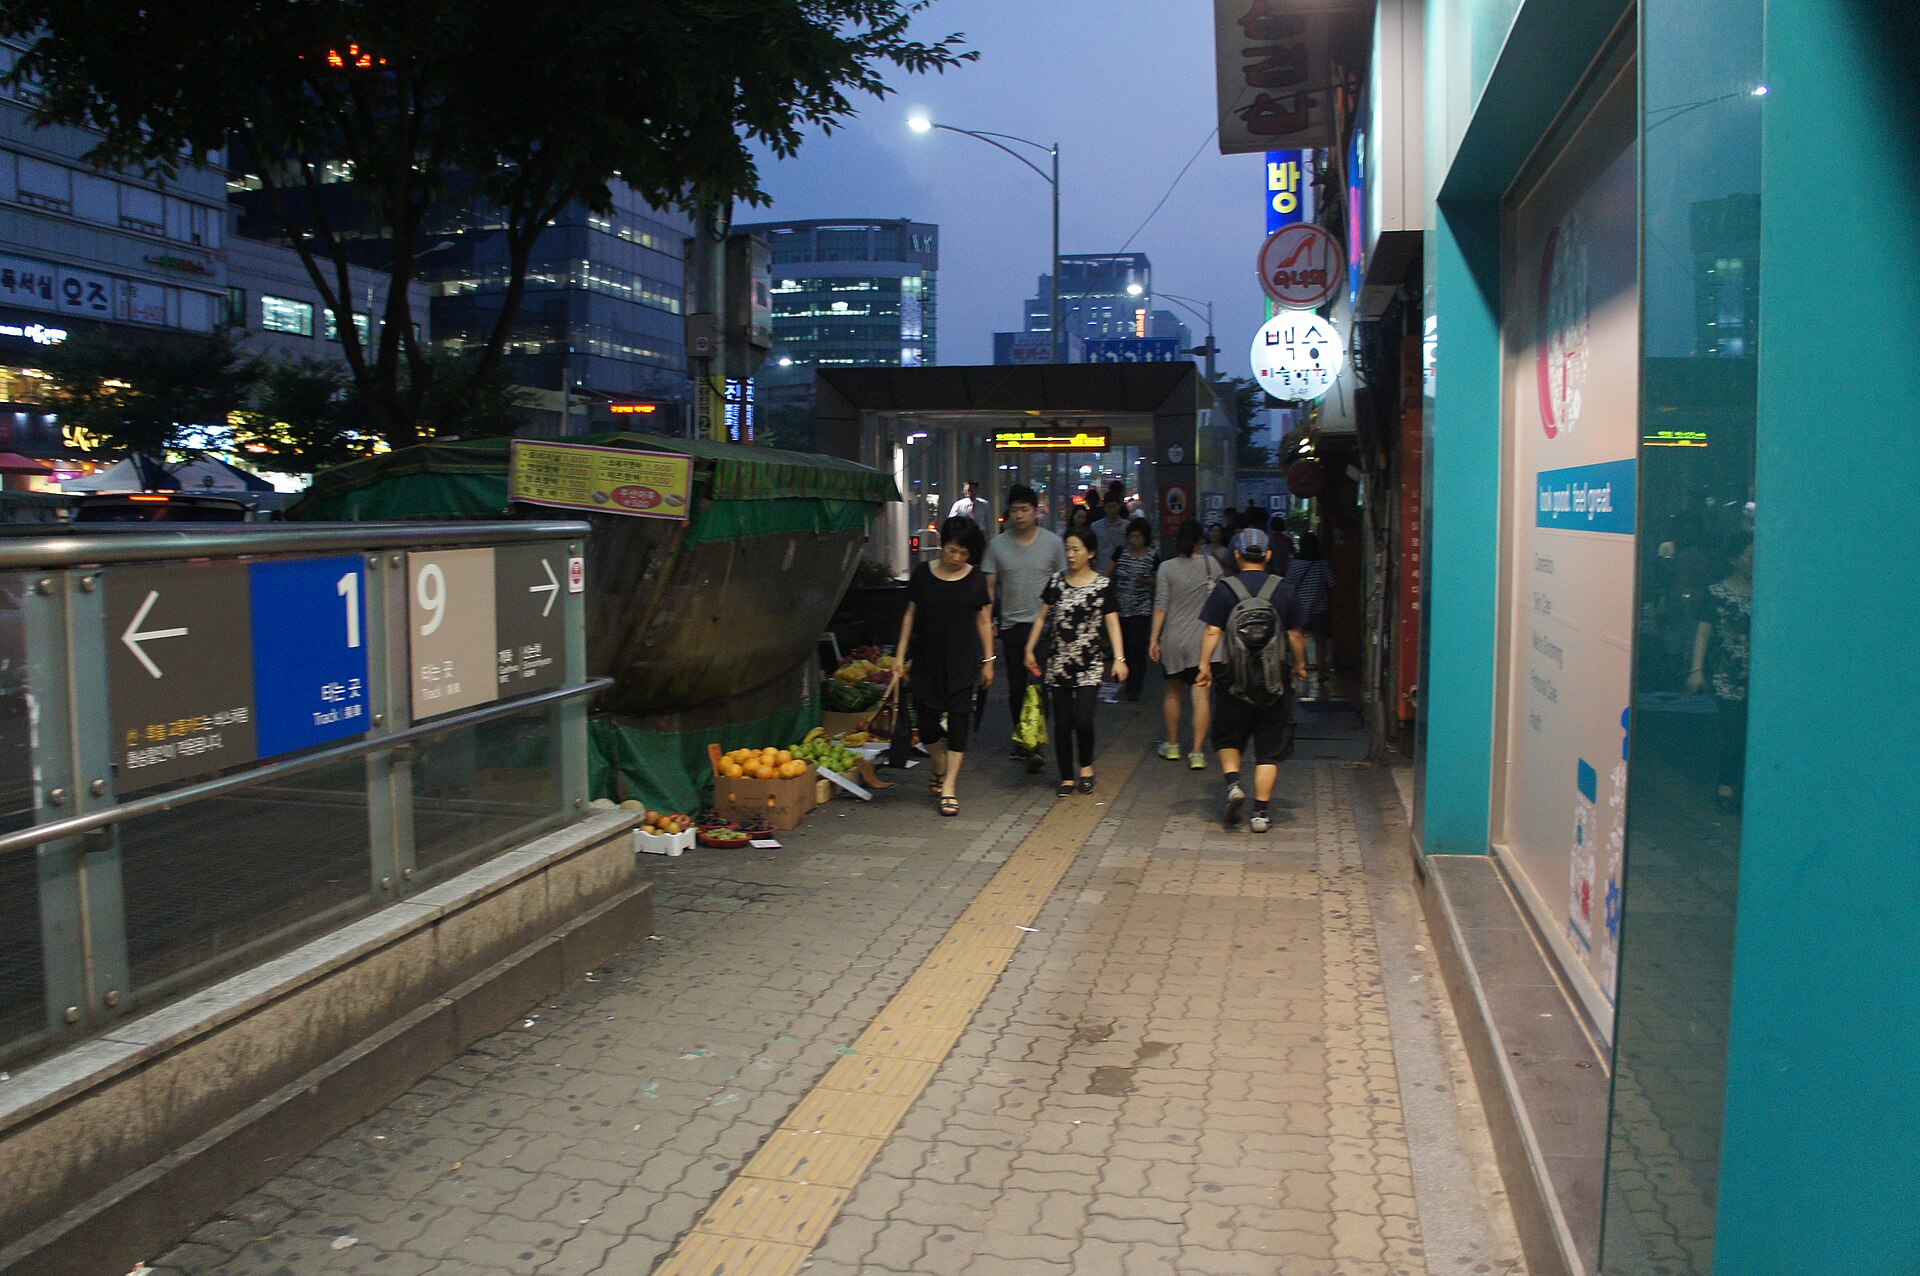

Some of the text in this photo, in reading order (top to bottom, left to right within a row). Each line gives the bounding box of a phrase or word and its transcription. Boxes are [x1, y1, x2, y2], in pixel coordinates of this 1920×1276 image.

[1267, 161, 1301, 214] 방
[63, 277, 109, 311] 오즈
[337, 572, 360, 648] 1
[417, 563, 447, 636] 9
[320, 678, 361, 703] 타는 곳
[421, 660, 454, 682] 타는 곳
